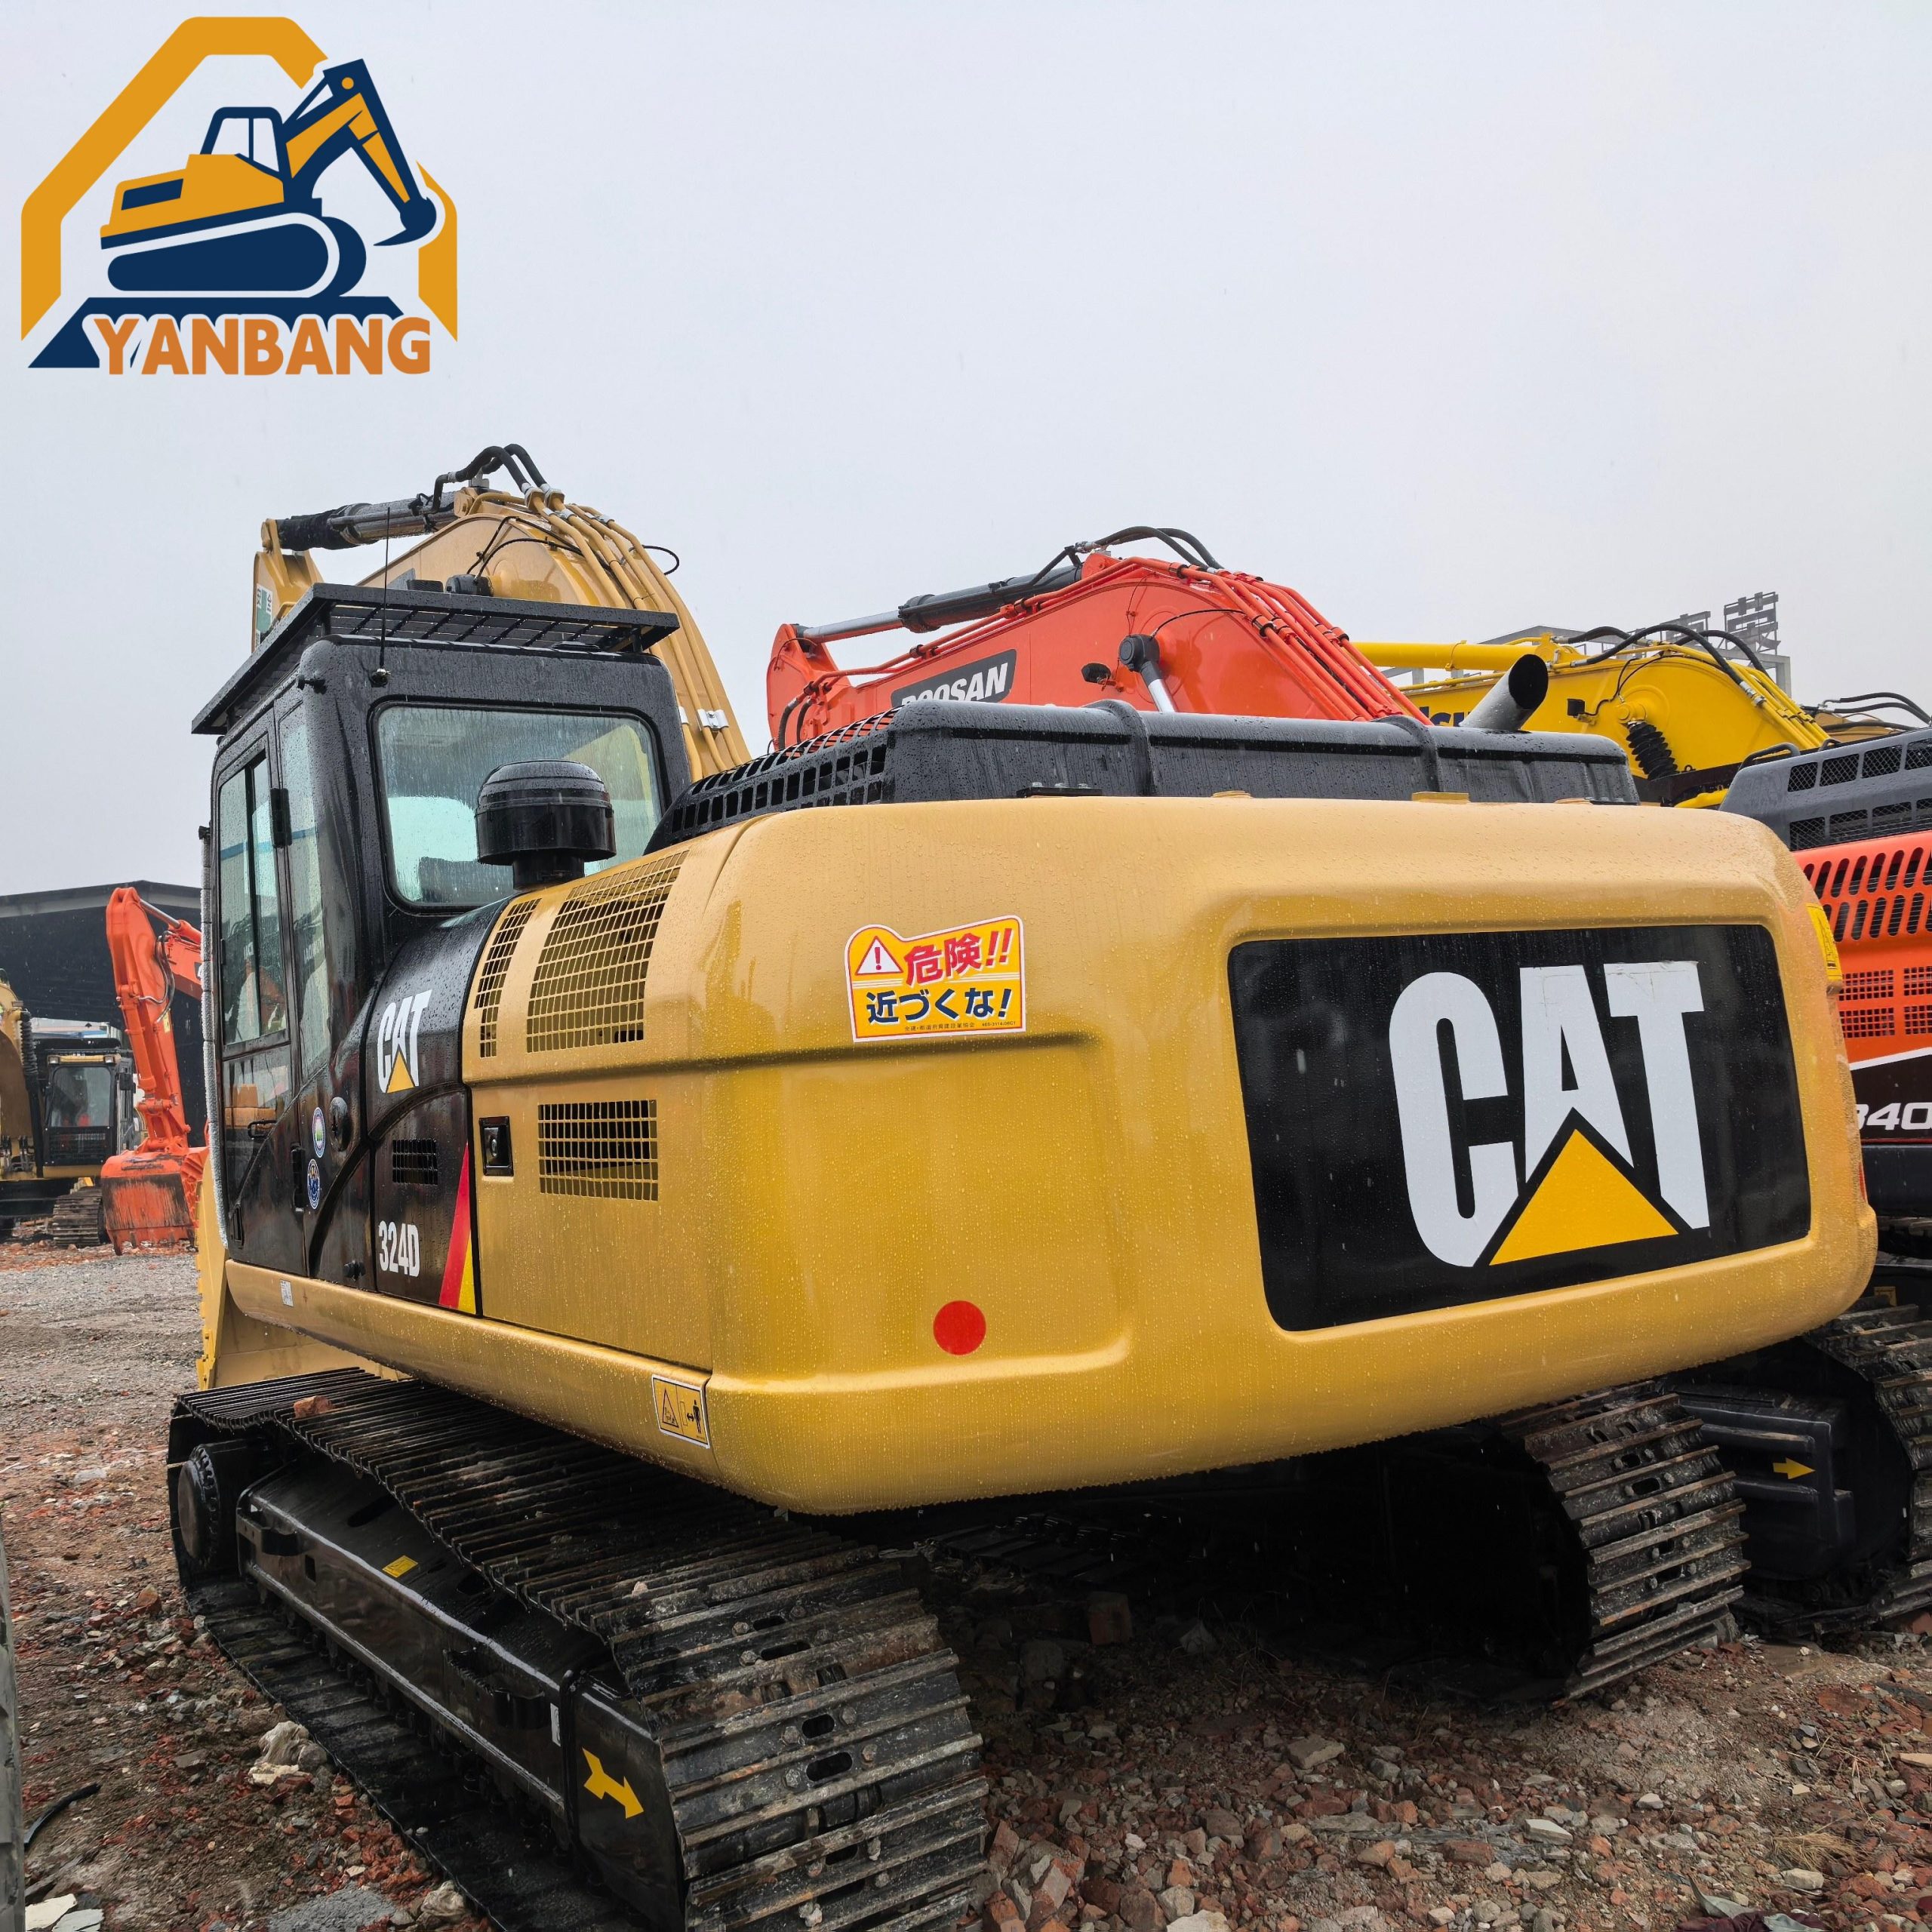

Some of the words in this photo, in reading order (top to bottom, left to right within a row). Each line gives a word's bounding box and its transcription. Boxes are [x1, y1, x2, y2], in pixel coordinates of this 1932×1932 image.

[902, 662, 1008, 703] OSAN
[377, 989, 433, 1094] CAT
[1389, 960, 1710, 1267] CAT
[378, 1220, 420, 1277] 324D
